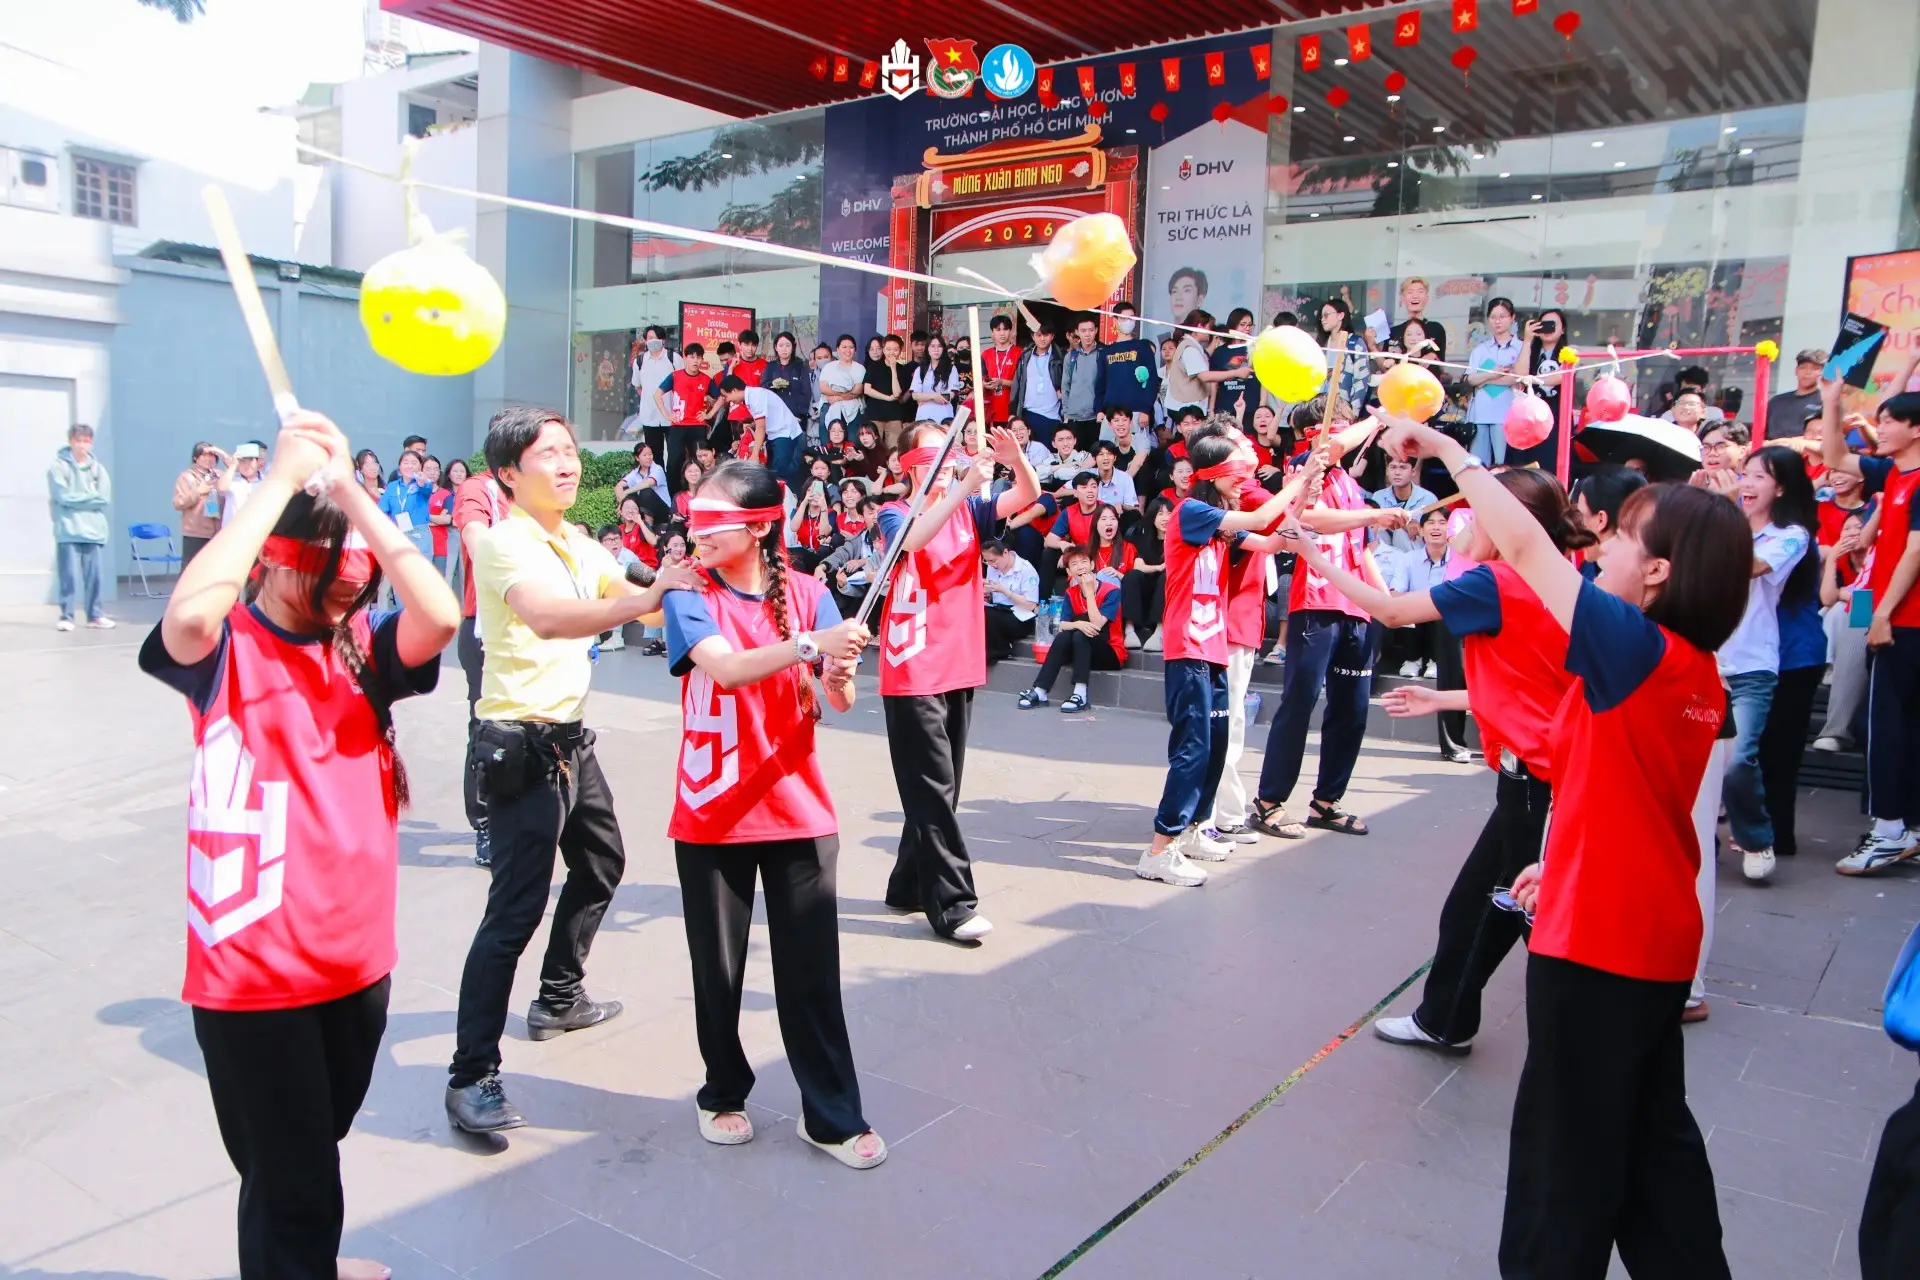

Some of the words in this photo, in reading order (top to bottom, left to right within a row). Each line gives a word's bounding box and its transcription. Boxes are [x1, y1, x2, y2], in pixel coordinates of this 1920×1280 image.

[925, 112, 978, 132] TRƯỜNG
[1008, 102, 1036, 119] HỌC
[944, 129, 988, 148] THÀNH
[992, 121, 1020, 139] PHỐ
[1024, 117, 1044, 137] HỒ
[1048, 114, 1072, 132] CHÍ
[1040, 163, 1063, 185] NGỌ
[1196, 159, 1235, 176] DHV
[853, 198, 882, 213] DHV
[1158, 210, 1181, 224] TRI
[1185, 204, 1228, 222] THỨC
[1232, 201, 1253, 218] LÀ
[984, 222, 1053, 242] 2026
[1168, 225, 1199, 242] SỨC
[1203, 223, 1251, 241] MẠNH
[831, 236, 890, 253] WELCOME
